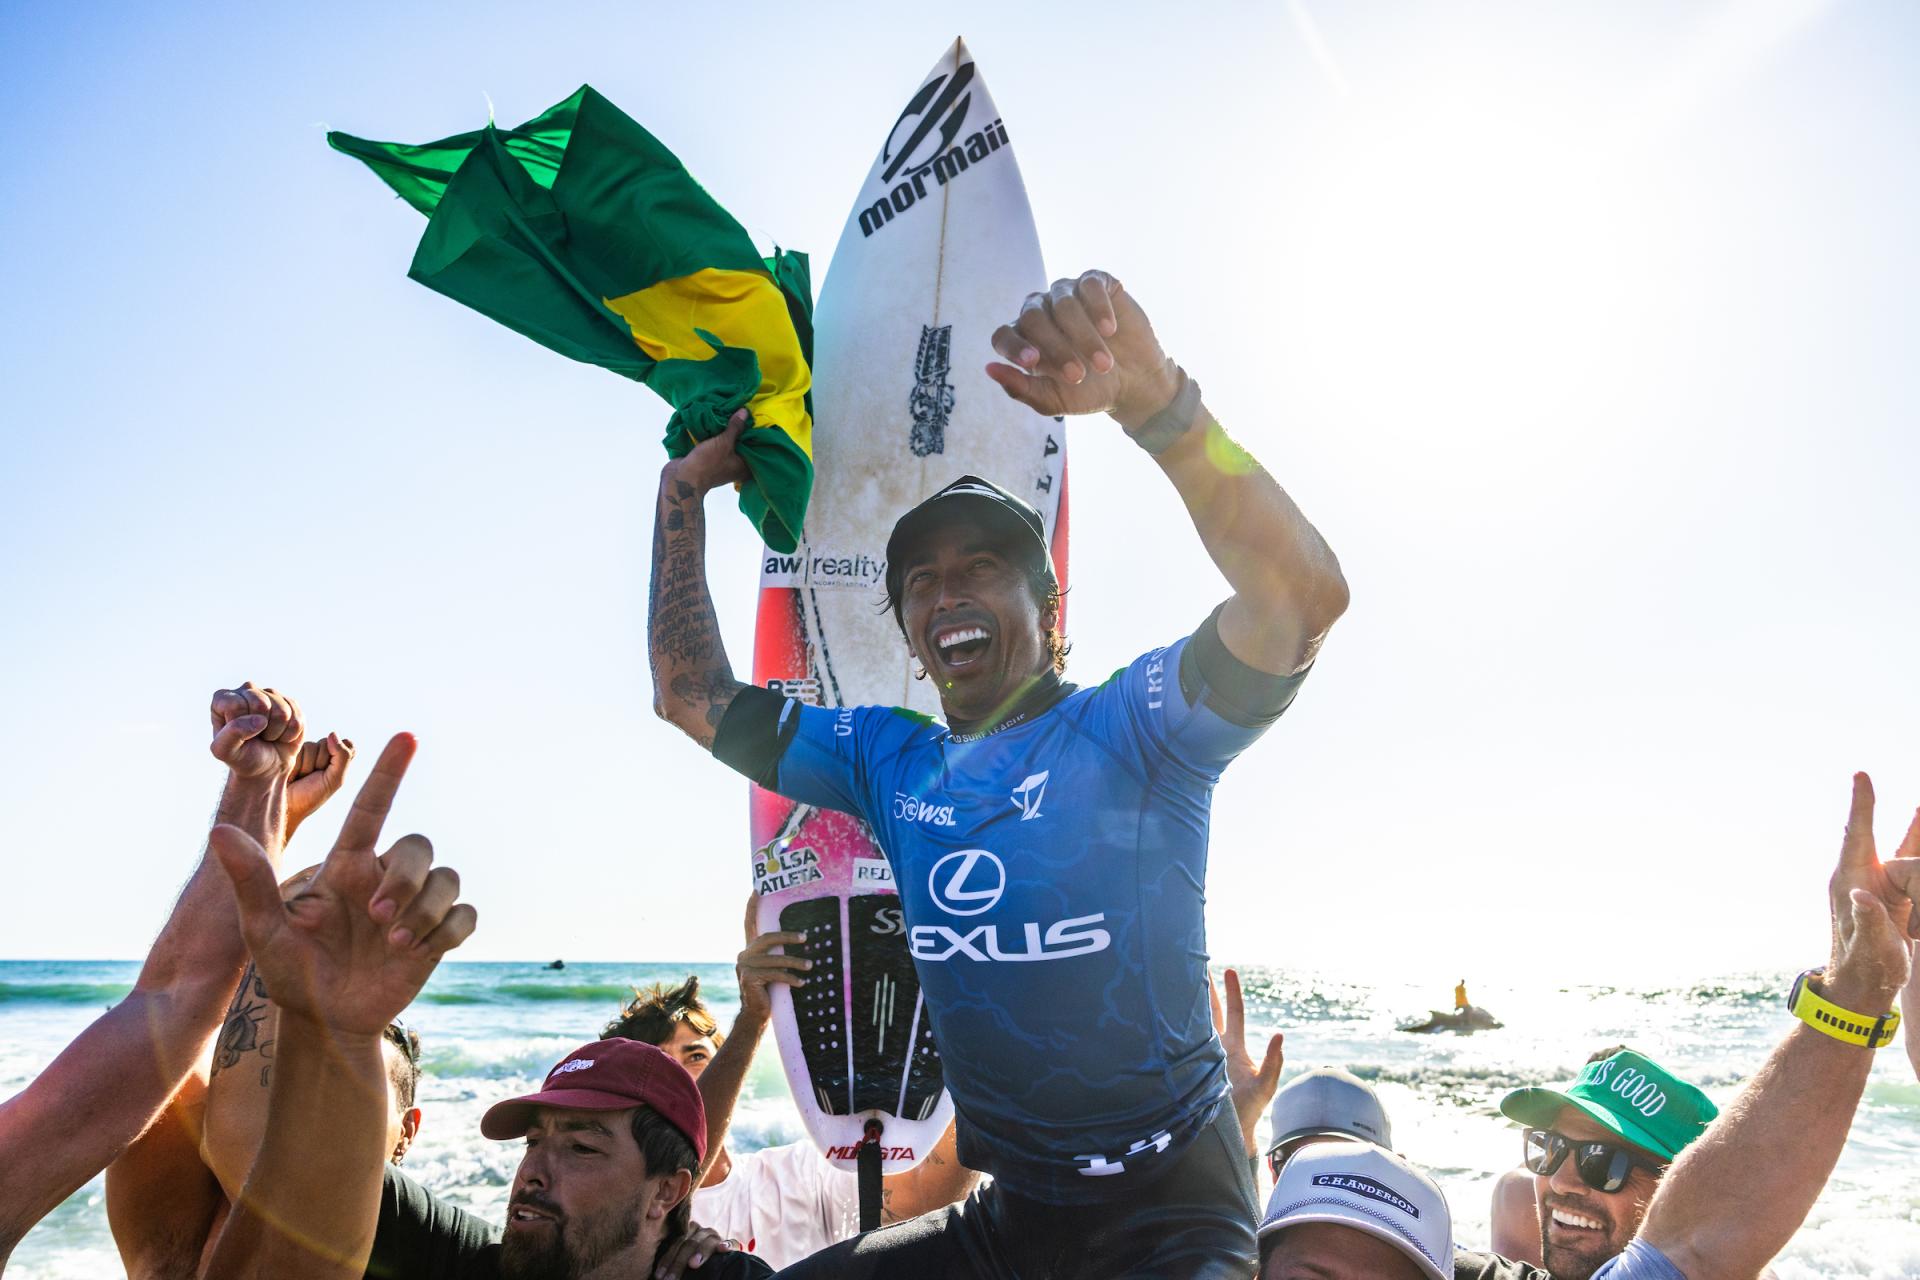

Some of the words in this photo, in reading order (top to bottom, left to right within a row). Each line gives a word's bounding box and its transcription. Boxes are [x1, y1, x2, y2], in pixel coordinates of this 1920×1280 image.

[858, 117, 1010, 238] mormaii
[765, 557, 803, 575] aw
[813, 553, 887, 584] realty
[917, 801, 957, 826] WSL
[760, 864, 823, 896] ATLETA
[909, 912, 1111, 962] EXUS
[1592, 1060, 1617, 1086] IS
[1610, 1067, 1667, 1117] GOOD
